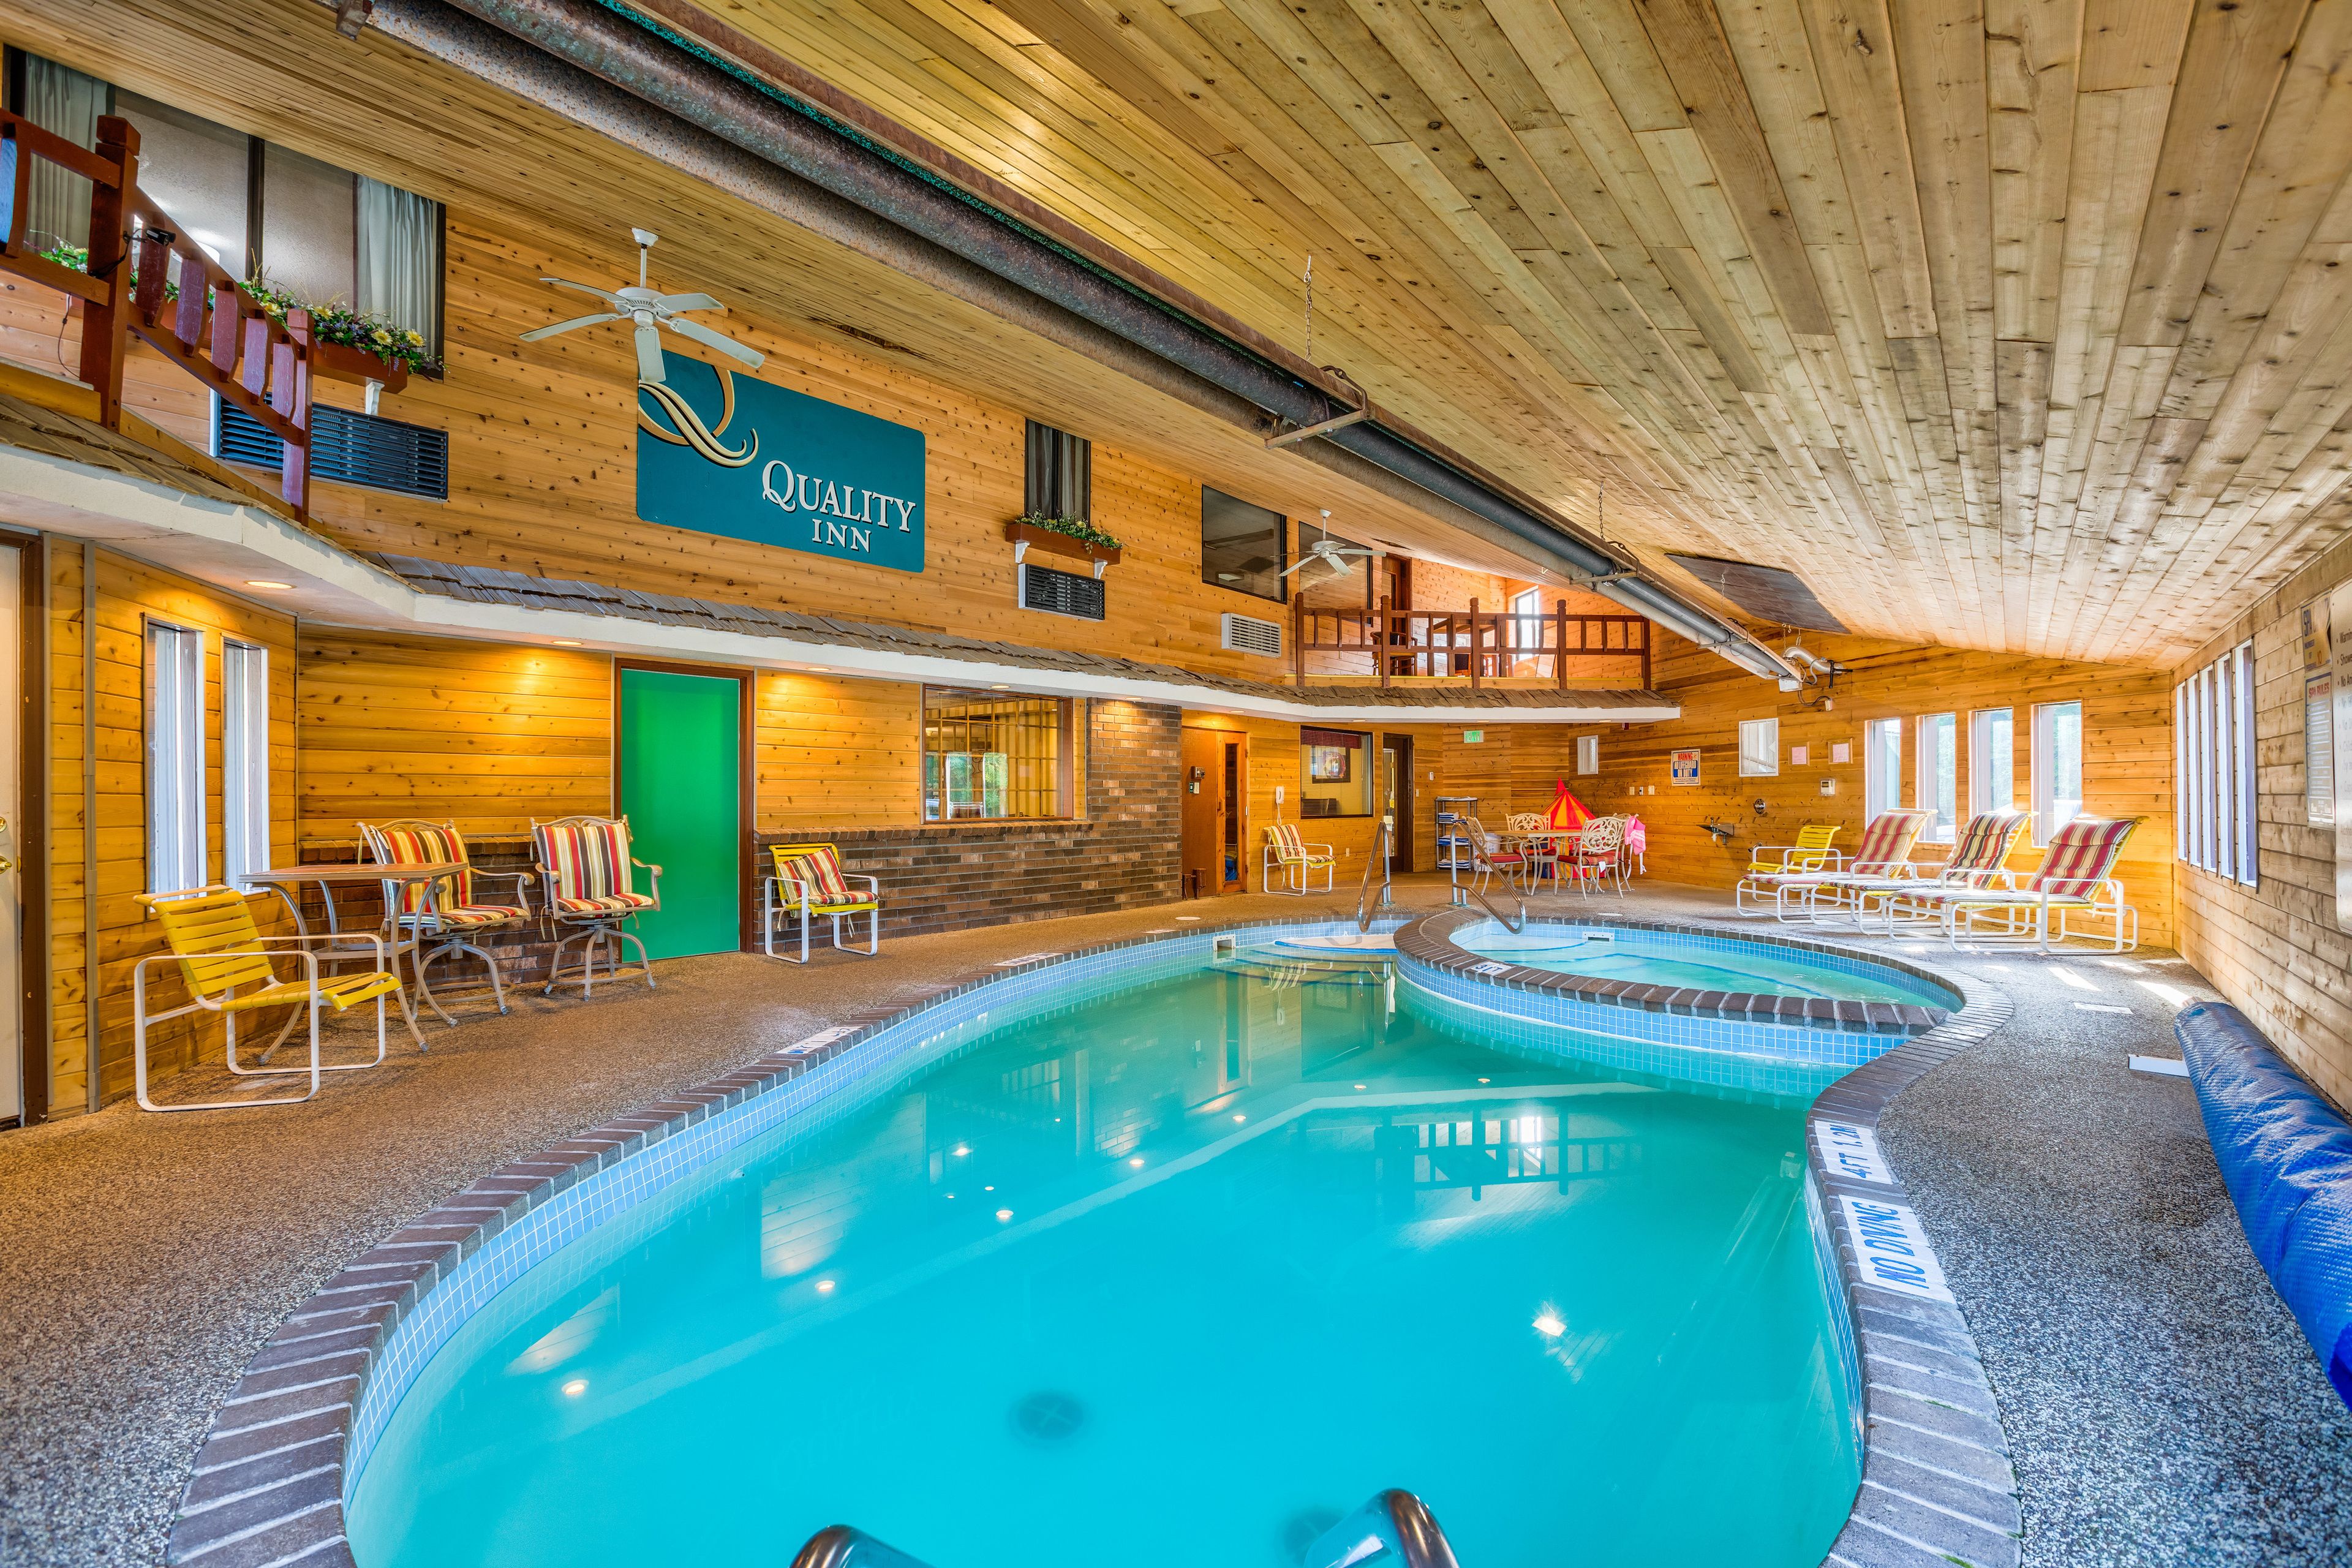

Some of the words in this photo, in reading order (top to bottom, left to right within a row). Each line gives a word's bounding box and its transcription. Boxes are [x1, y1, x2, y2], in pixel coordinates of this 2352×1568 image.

[762, 460, 916, 532] QUALITY
[812, 519, 872, 553] INN
[2317, 682, 2330, 696] RULES
[1467, 731, 1480, 742] EXIT
[1678, 752, 1692, 761] WARNING
[1683, 769, 1693, 777] DUTY
[1851, 1201, 1916, 1257] DIVING
[1870, 1257, 1930, 1289] NO
